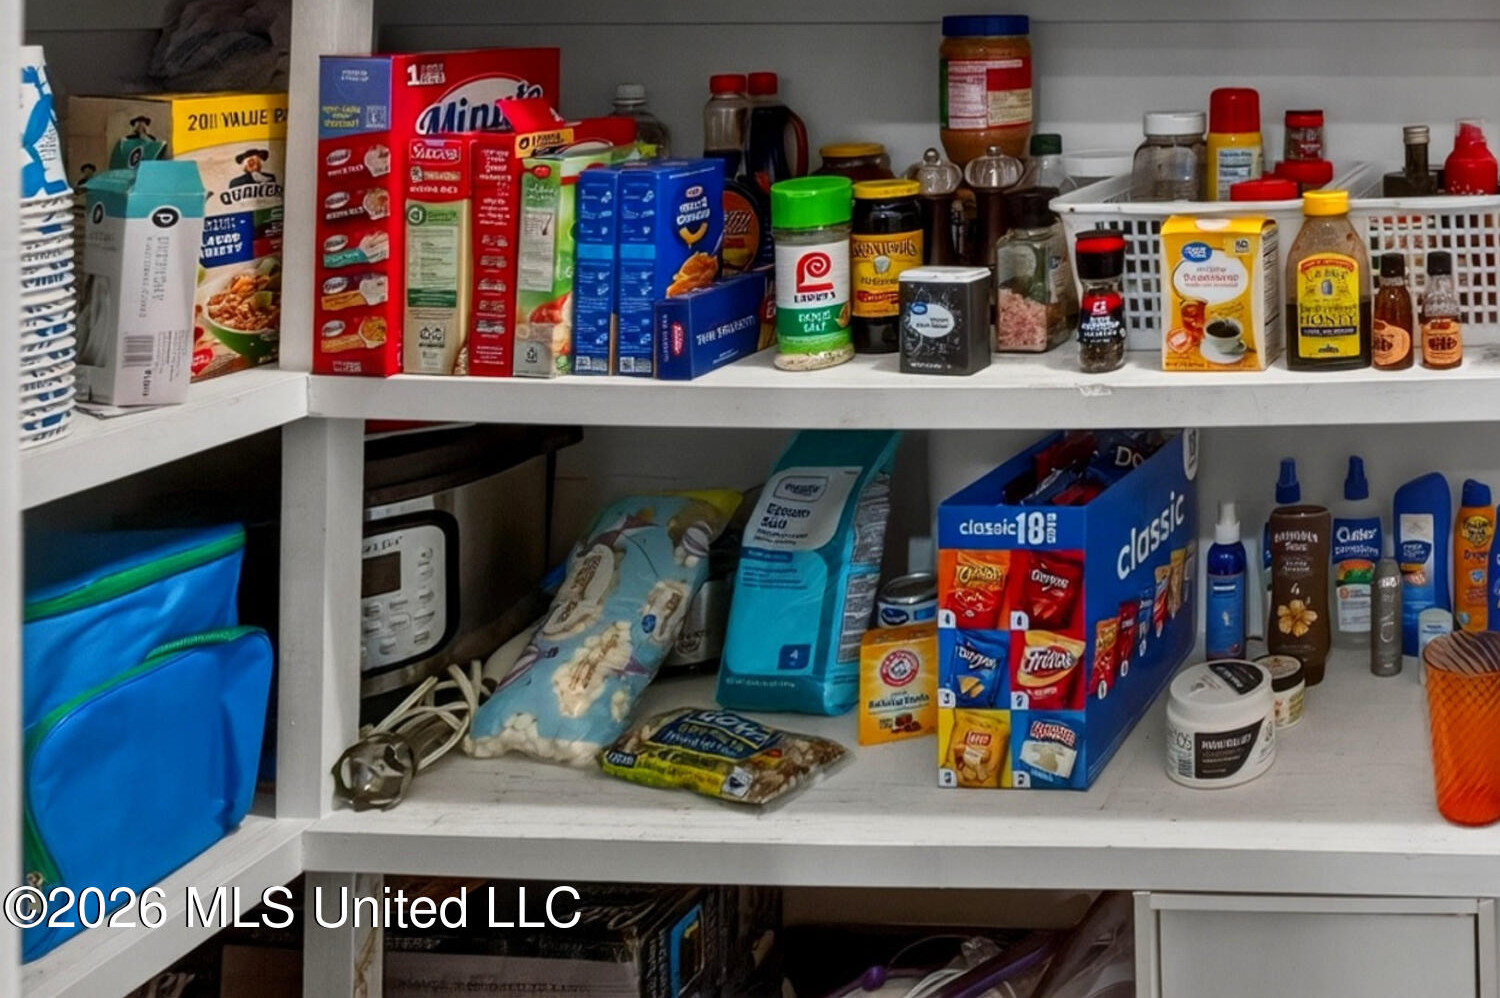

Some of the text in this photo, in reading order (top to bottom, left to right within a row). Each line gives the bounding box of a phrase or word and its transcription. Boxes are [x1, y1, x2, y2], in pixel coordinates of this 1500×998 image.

[221, 109, 268, 129] VALUE
[1301, 313, 1356, 326] HONEY
[959, 511, 1045, 545] classic 18
[1116, 491, 1185, 580] classic
